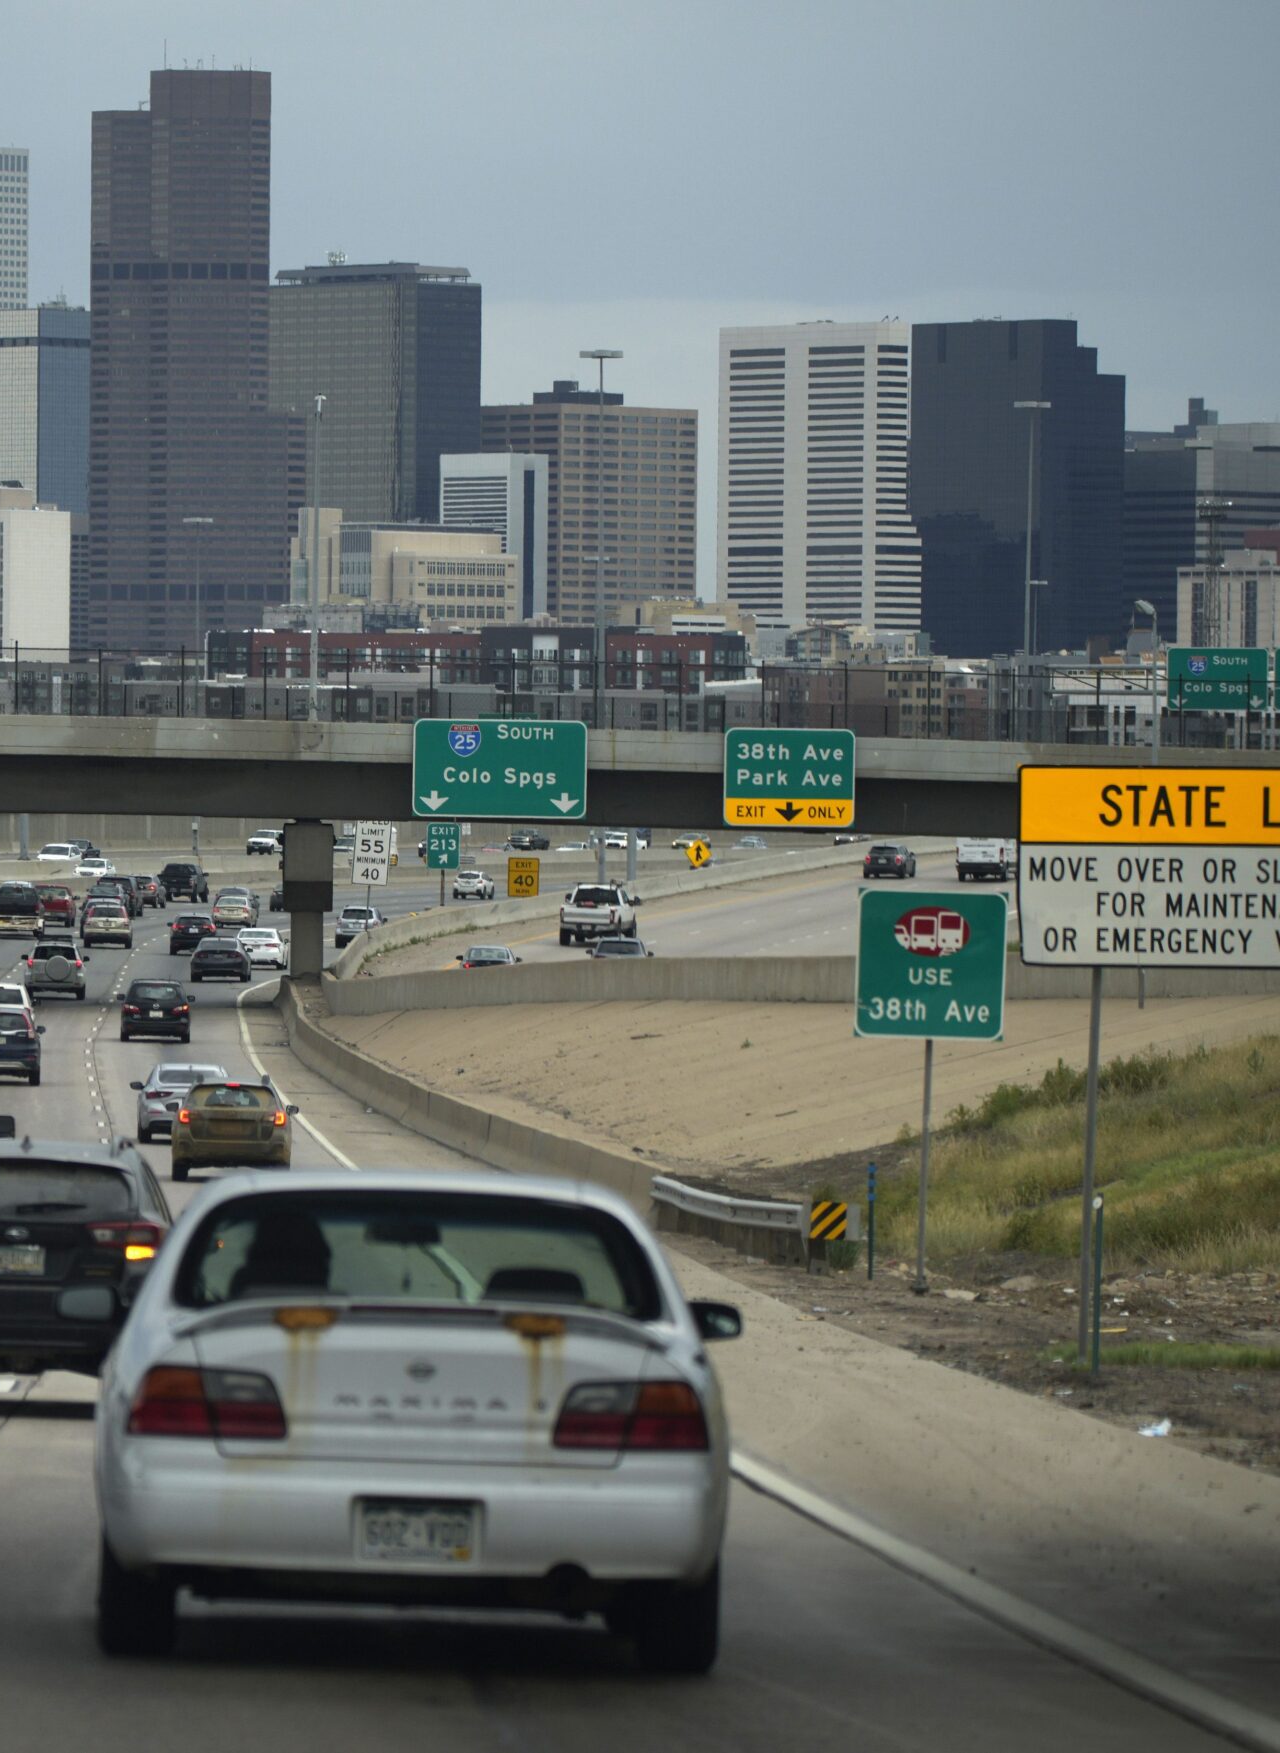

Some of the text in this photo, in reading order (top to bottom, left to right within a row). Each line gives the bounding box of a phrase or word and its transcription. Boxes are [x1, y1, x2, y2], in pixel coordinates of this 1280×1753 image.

[1191, 662, 1205, 672] 25
[1212, 655, 1248, 665] SOUTH
[1184, 682, 1212, 693] Colo
[497, 724, 554, 740] SOUTH
[454, 734, 476, 750] 25
[737, 743, 844, 761] 38th Ave
[443, 767, 557, 790] Colo Spgs
[736, 769, 843, 786] Park Ave
[736, 805, 846, 819] EXIT ONLY
[1099, 784, 1226, 827] STATE
[361, 827, 385, 836] LIMIT
[431, 827, 456, 835] EXIT
[361, 840, 384, 854] 55
[430, 839, 457, 851] 213
[356, 857, 386, 865] MINIMUM
[515, 861, 532, 869] EXIT
[361, 869, 379, 881] 40
[1029, 856, 1098, 882] MOVE
[1117, 858, 1183, 883] OVER
[1203, 859, 1236, 883] OR
[513, 875, 534, 887] 40
[1097, 892, 1145, 917] FOR
[1044, 927, 1077, 952] OR
[1097, 928, 1253, 954] EMERGENCY
[908, 967, 953, 986] USE
[868, 997, 990, 1024] 38th Ave
